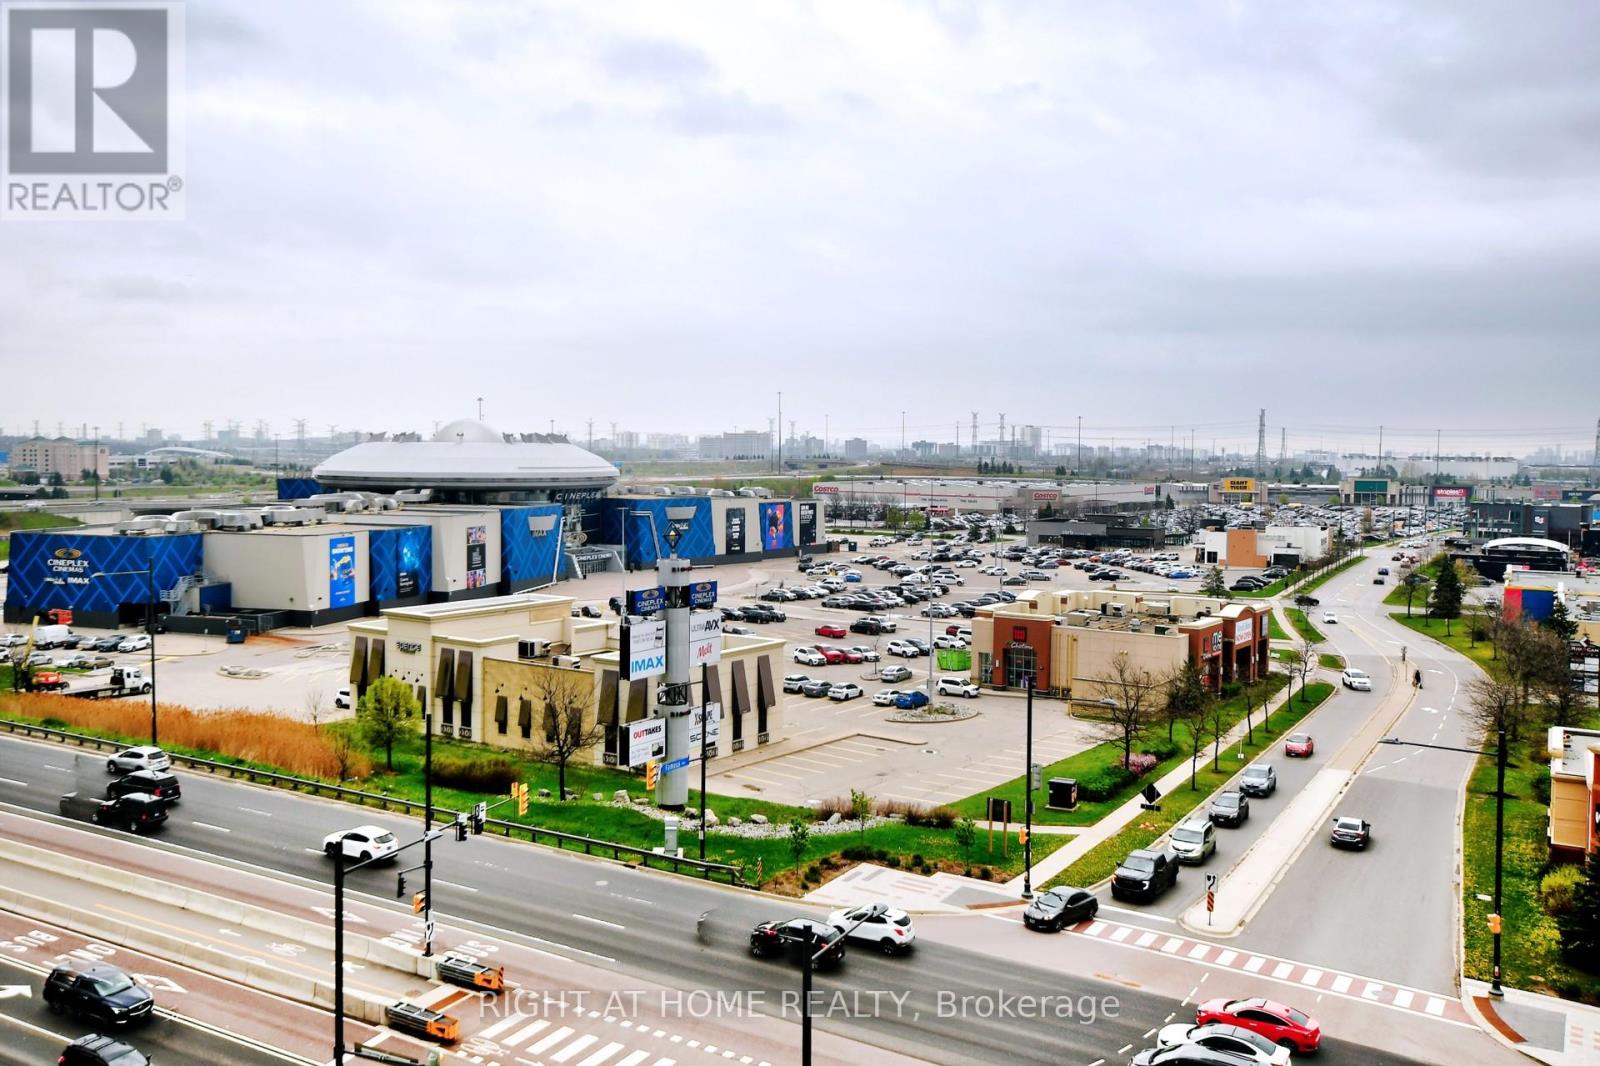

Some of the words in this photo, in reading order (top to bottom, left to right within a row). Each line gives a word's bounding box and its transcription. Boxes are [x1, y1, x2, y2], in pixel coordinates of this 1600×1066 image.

[47, 559, 89, 567] CINEPLEX
[67, 576, 90, 584] IMAX
[691, 591, 715, 600] CINEPLEX
[637, 598, 664, 608] CINEPLEX
[631, 655, 664, 673] IMAX
[633, 725, 662, 739] OUTTAKES
[689, 728, 719, 743] SCNE
